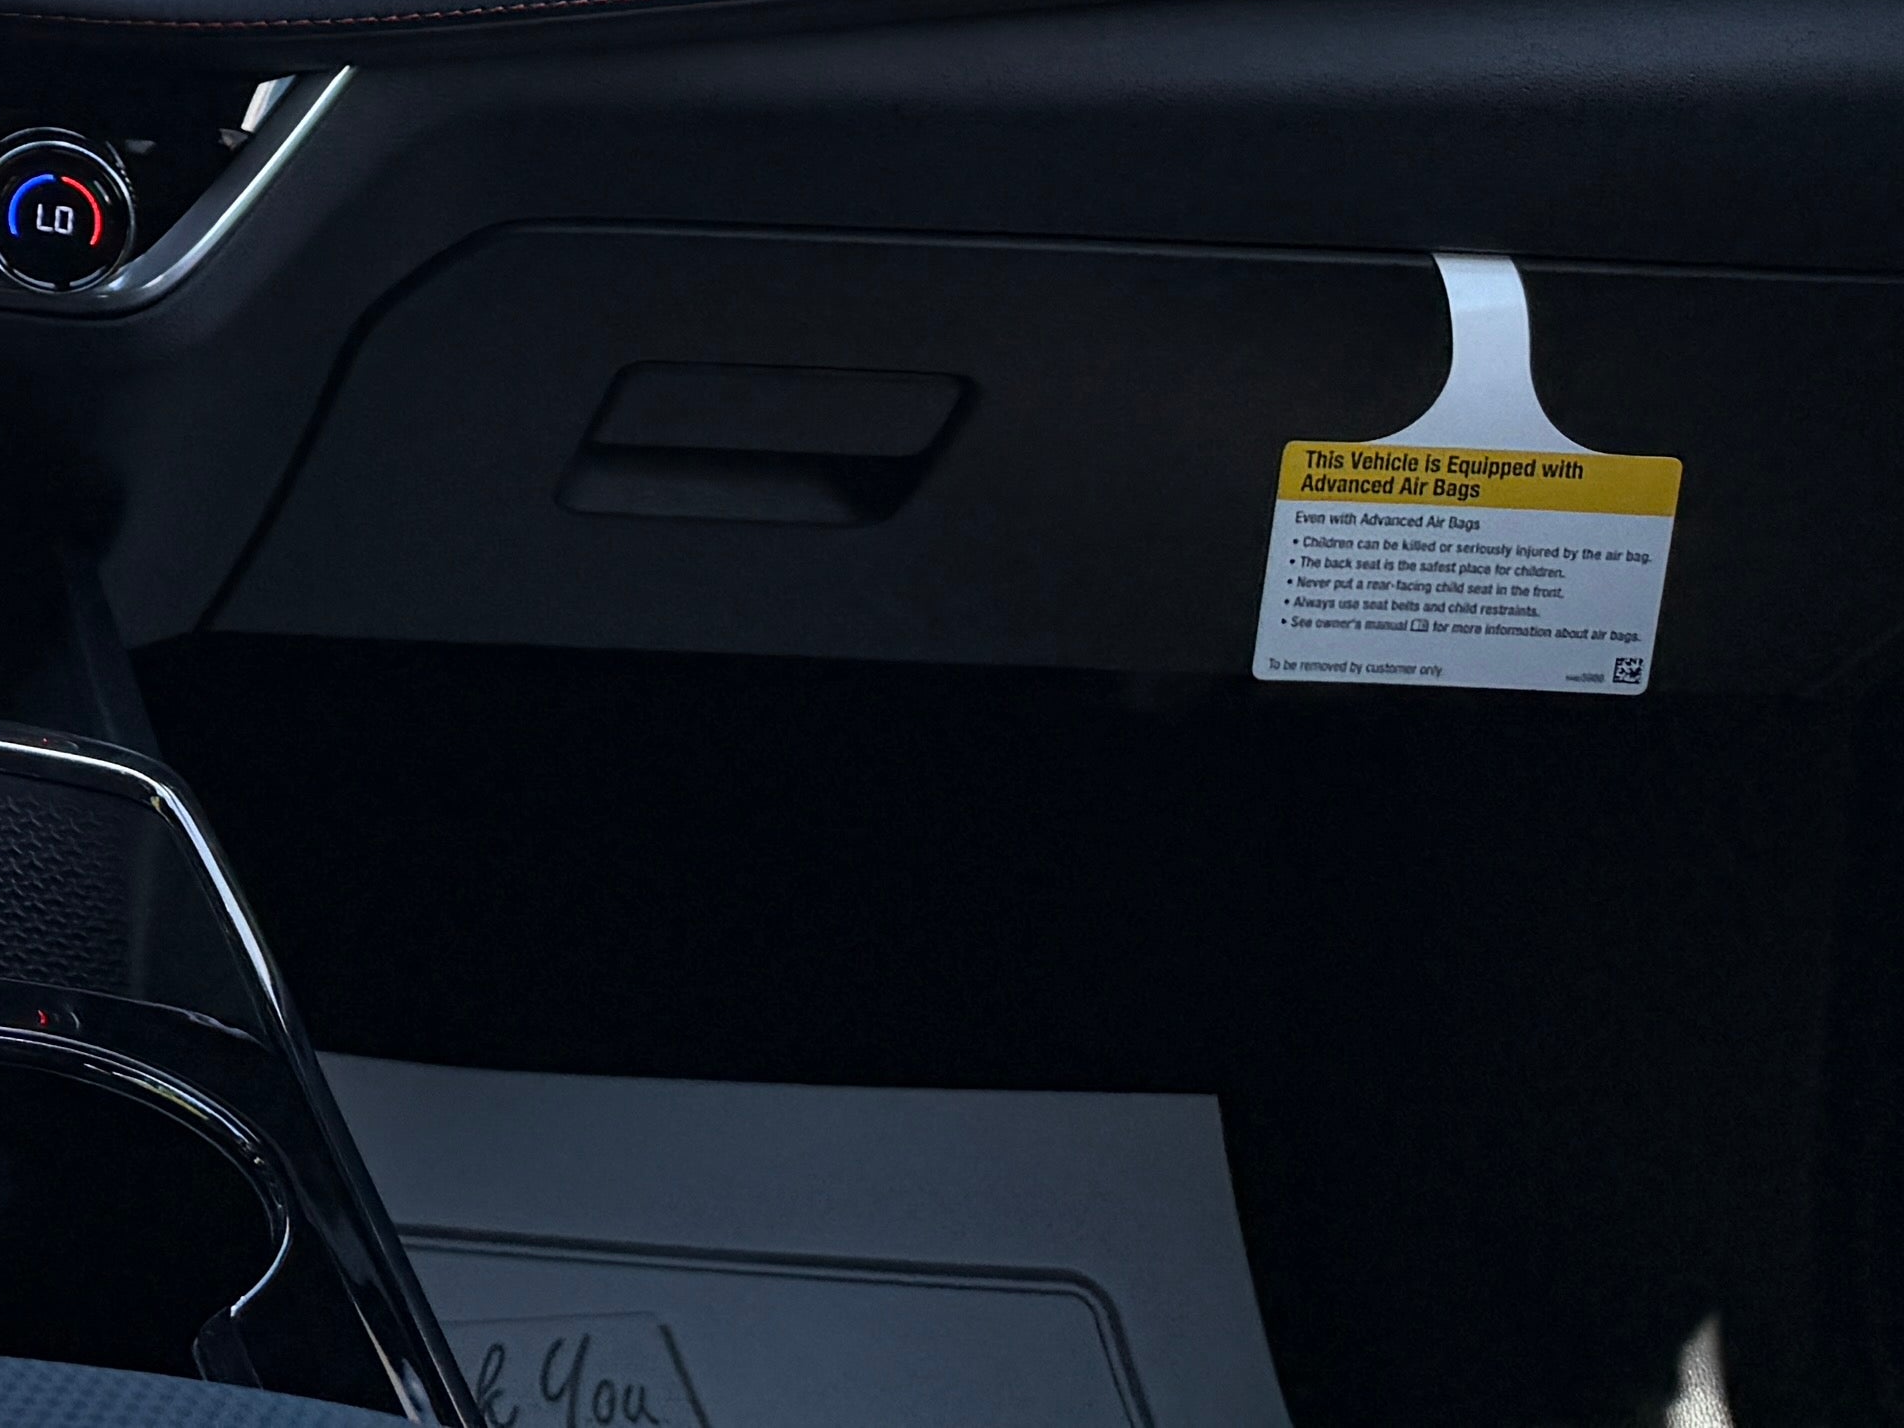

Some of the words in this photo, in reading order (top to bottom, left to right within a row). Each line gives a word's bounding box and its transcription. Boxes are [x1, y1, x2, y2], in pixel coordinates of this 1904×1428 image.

[36, 203, 74, 235] LO
[1306, 450, 1344, 469] This
[1351, 451, 1418, 472] Vehicle
[1425, 453, 1441, 473] is
[1447, 455, 1536, 479] Equipped
[1542, 459, 1583, 479] with
[1301, 473, 1394, 494] Advanced
[1399, 477, 1428, 496] Air
[1433, 478, 1480, 501] Bags
[1295, 510, 1325, 524] Even
[1330, 512, 1356, 525] with
[1360, 513, 1423, 528] Advanced
[1426, 516, 1445, 529] Air
[1448, 517, 1480, 532] Bags
[1303, 536, 1353, 549] Children
[1357, 540, 1379, 550] can
[1384, 540, 1398, 551] be
[1402, 541, 1435, 552] killed
[1439, 543, 1452, 553] or
[1456, 543, 1512, 558] seriously
[1516, 545, 1559, 559] injured
[1563, 547, 1578, 561] by
[1582, 548, 1601, 560] the
[1605, 550, 1623, 561] air
[1301, 556, 1321, 568] The
[1324, 557, 1352, 569] back
[1355, 559, 1381, 570] seat
[1384, 559, 1393, 570] is
[1398, 559, 1416, 571] the
[1419, 561, 1457, 572] safest
[1459, 563, 1491, 575] place
[1495, 564, 1510, 576] for
[1297, 576, 1331, 588] Never
[1333, 578, 1353, 590] put
[1356, 580, 1363, 589] a
[1436, 582, 1464, 593] child
[1467, 583, 1493, 594] seat
[1496, 583, 1507, 595] in
[1511, 585, 1530, 597] the
[1294, 596, 1335, 611] Always
[1339, 599, 1359, 610] use
[1363, 599, 1388, 611] seat
[1391, 600, 1420, 612] belts
[1423, 602, 1445, 613] and
[1448, 602, 1477, 614] child
[1291, 616, 1312, 628] See
[1365, 620, 1407, 631] manual
[1433, 621, 1449, 632] for
[1451, 624, 1482, 634] more
[1485, 624, 1552, 638] information
[1554, 627, 1588, 639] about
[1591, 629, 1607, 640] air
[1268, 658, 1281, 670] To
[1283, 660, 1296, 671] be
[1300, 660, 1348, 672] removed
[1350, 662, 1362, 674] by
[1366, 663, 1416, 674] customer
[1420, 665, 1442, 677] only
[539, 1332, 658, 1428] You
